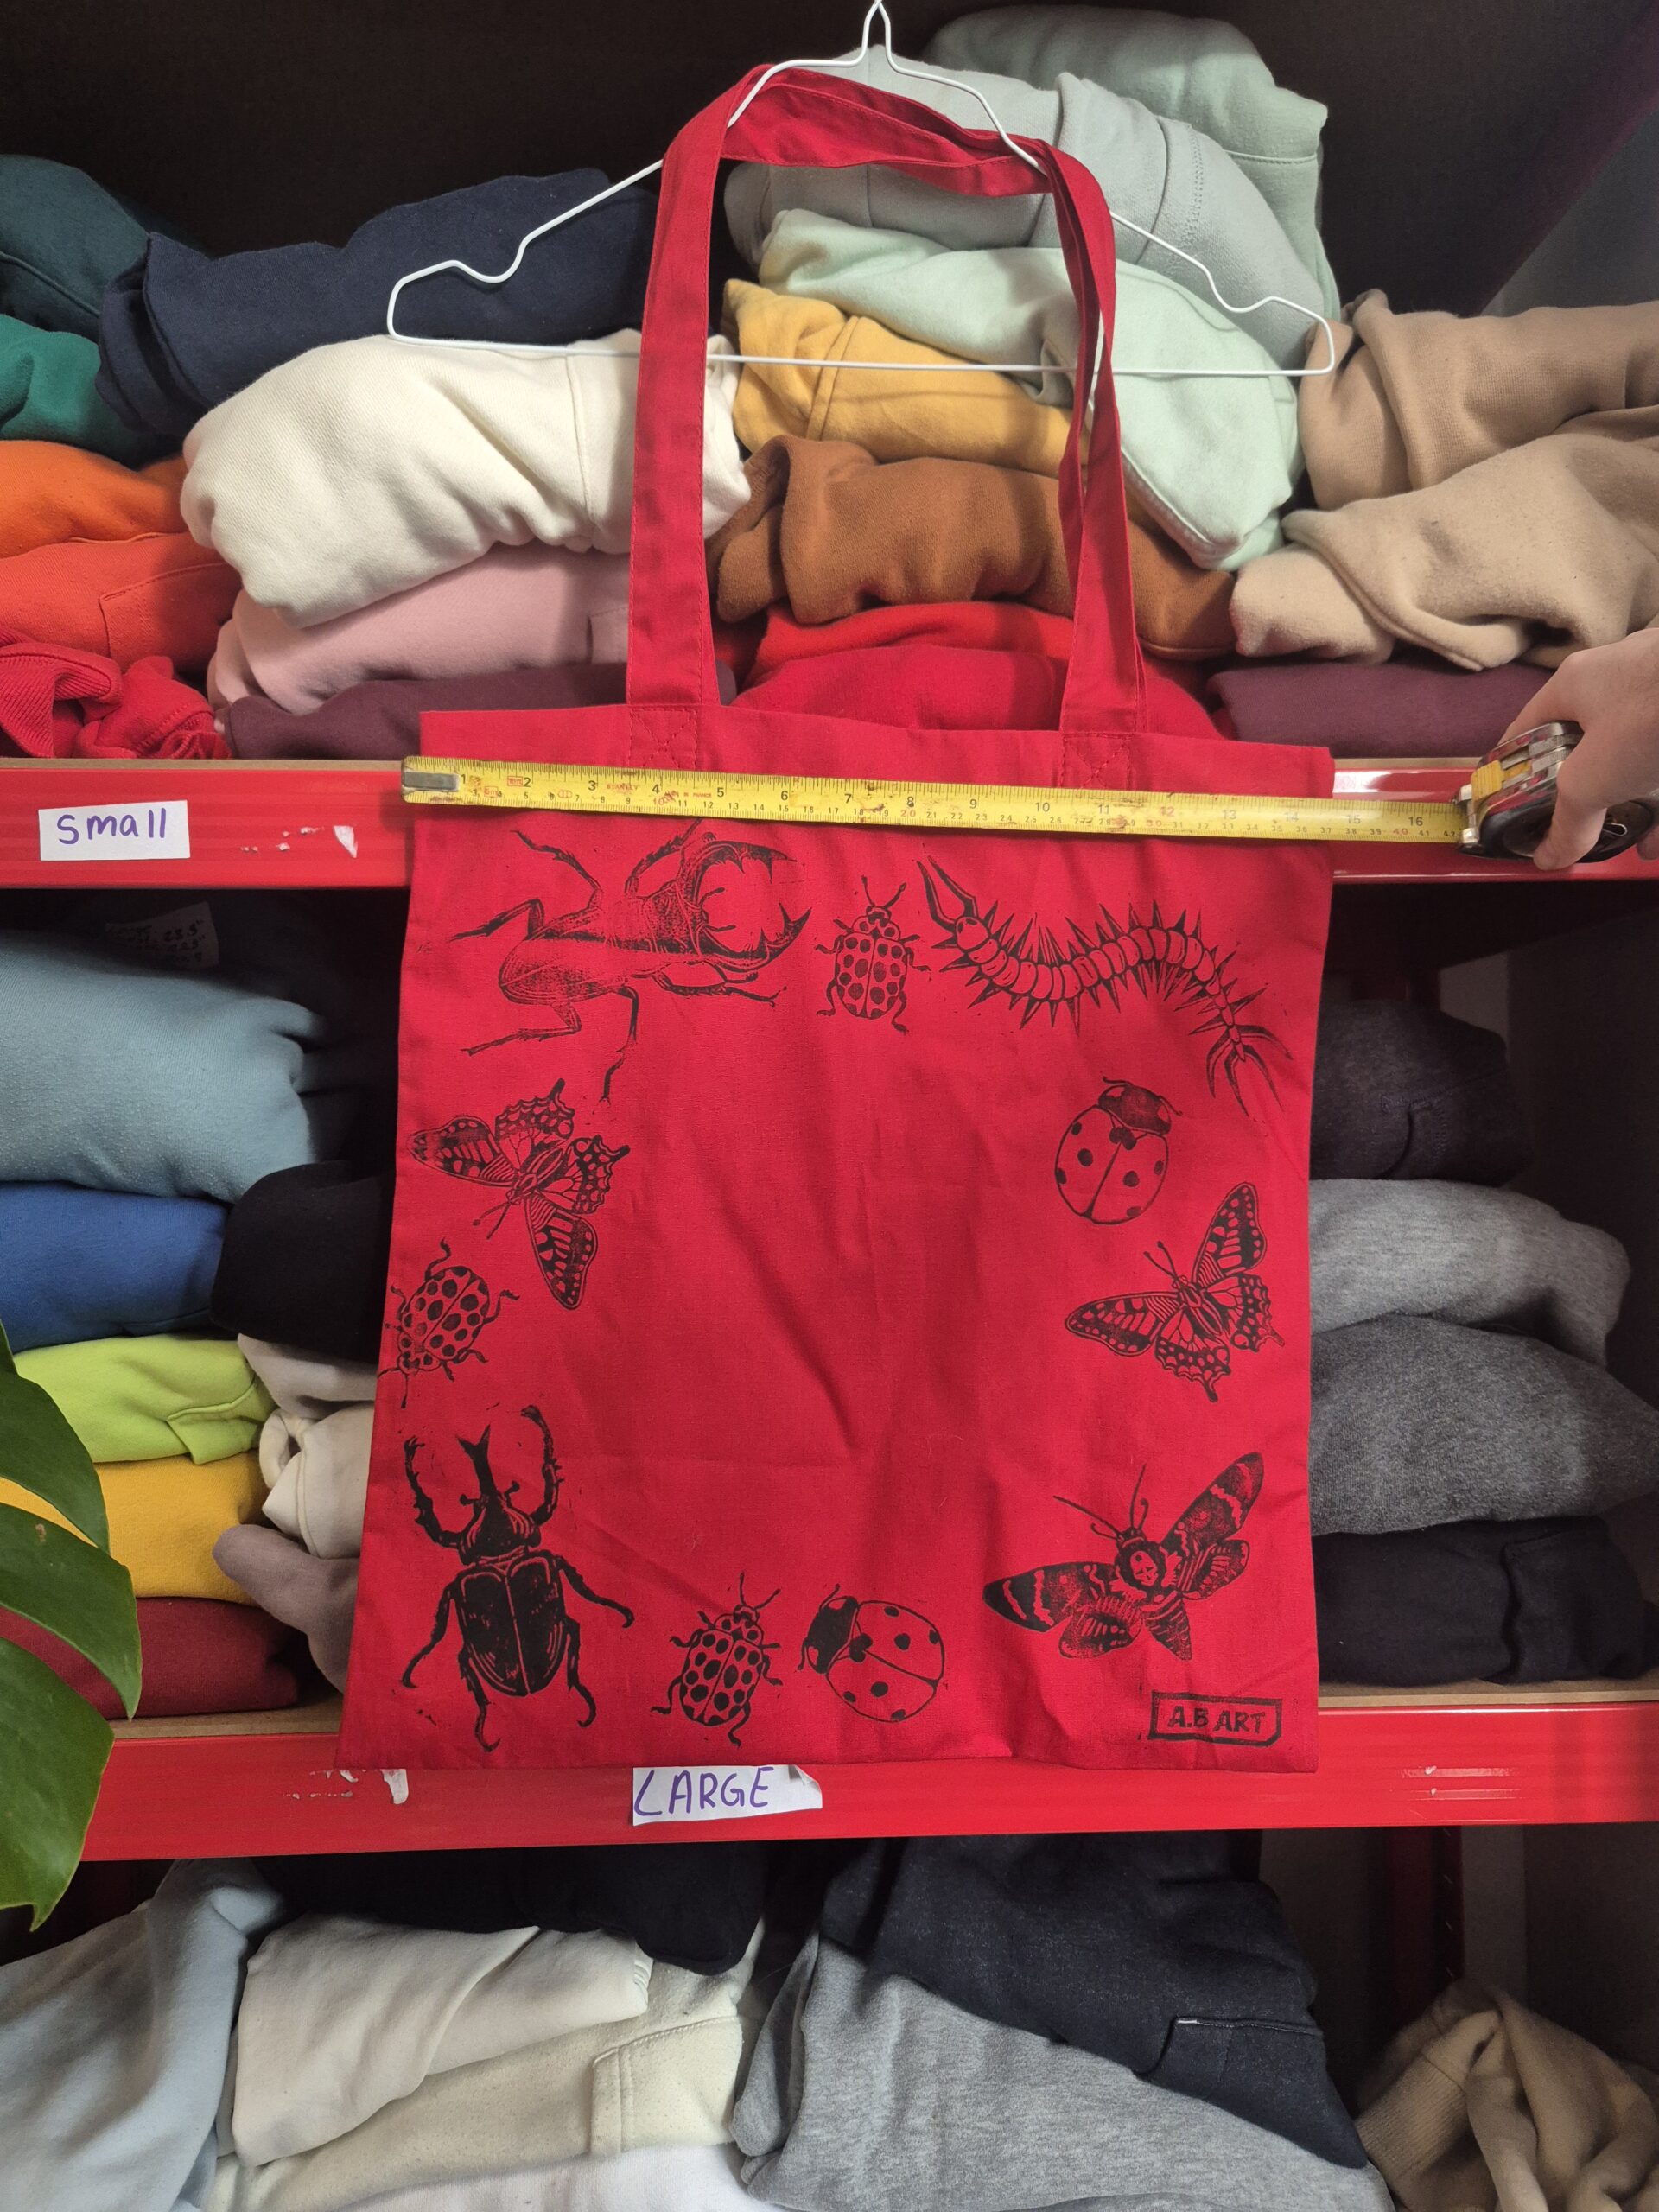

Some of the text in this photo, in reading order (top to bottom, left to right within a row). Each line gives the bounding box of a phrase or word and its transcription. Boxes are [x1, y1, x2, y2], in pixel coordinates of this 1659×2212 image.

[524, 777, 531, 787] 2
[588, 780, 596, 791] 3
[652, 785, 659, 794] 4
[716, 787, 724, 798] 5
[780, 791, 788, 800] 6
[844, 794, 852, 804] 7
[907, 797, 914, 807] 8
[969, 798, 977, 809] 9
[1035, 802, 1050, 812] 10
[1098, 804, 1109, 815] 11
[1160, 807, 1174, 817] 12
[1222, 810, 1237, 820] 13
[1346, 814, 1361, 823] 15
[1408, 817, 1423, 827] 16
[900, 809, 916, 817] 20
[1212, 1710, 1265, 1734] ART
[634, 1767, 774, 1815] LARGE
